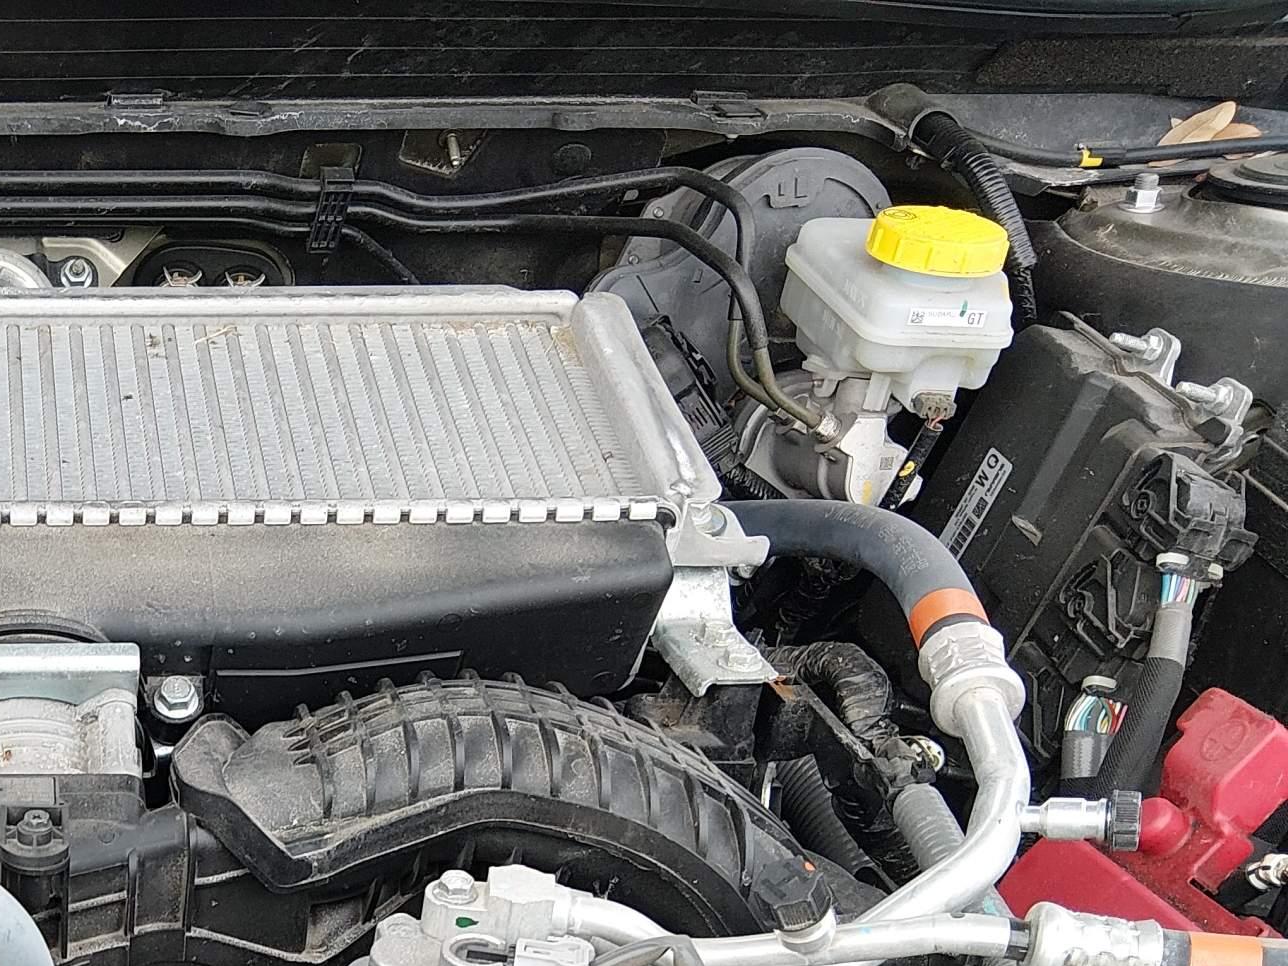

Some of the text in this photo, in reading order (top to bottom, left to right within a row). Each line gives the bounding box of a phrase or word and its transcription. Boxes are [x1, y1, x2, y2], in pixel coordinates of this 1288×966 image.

[967, 312, 984, 325] GT
[975, 470, 989, 488] W
[987, 453, 999, 469] Q
